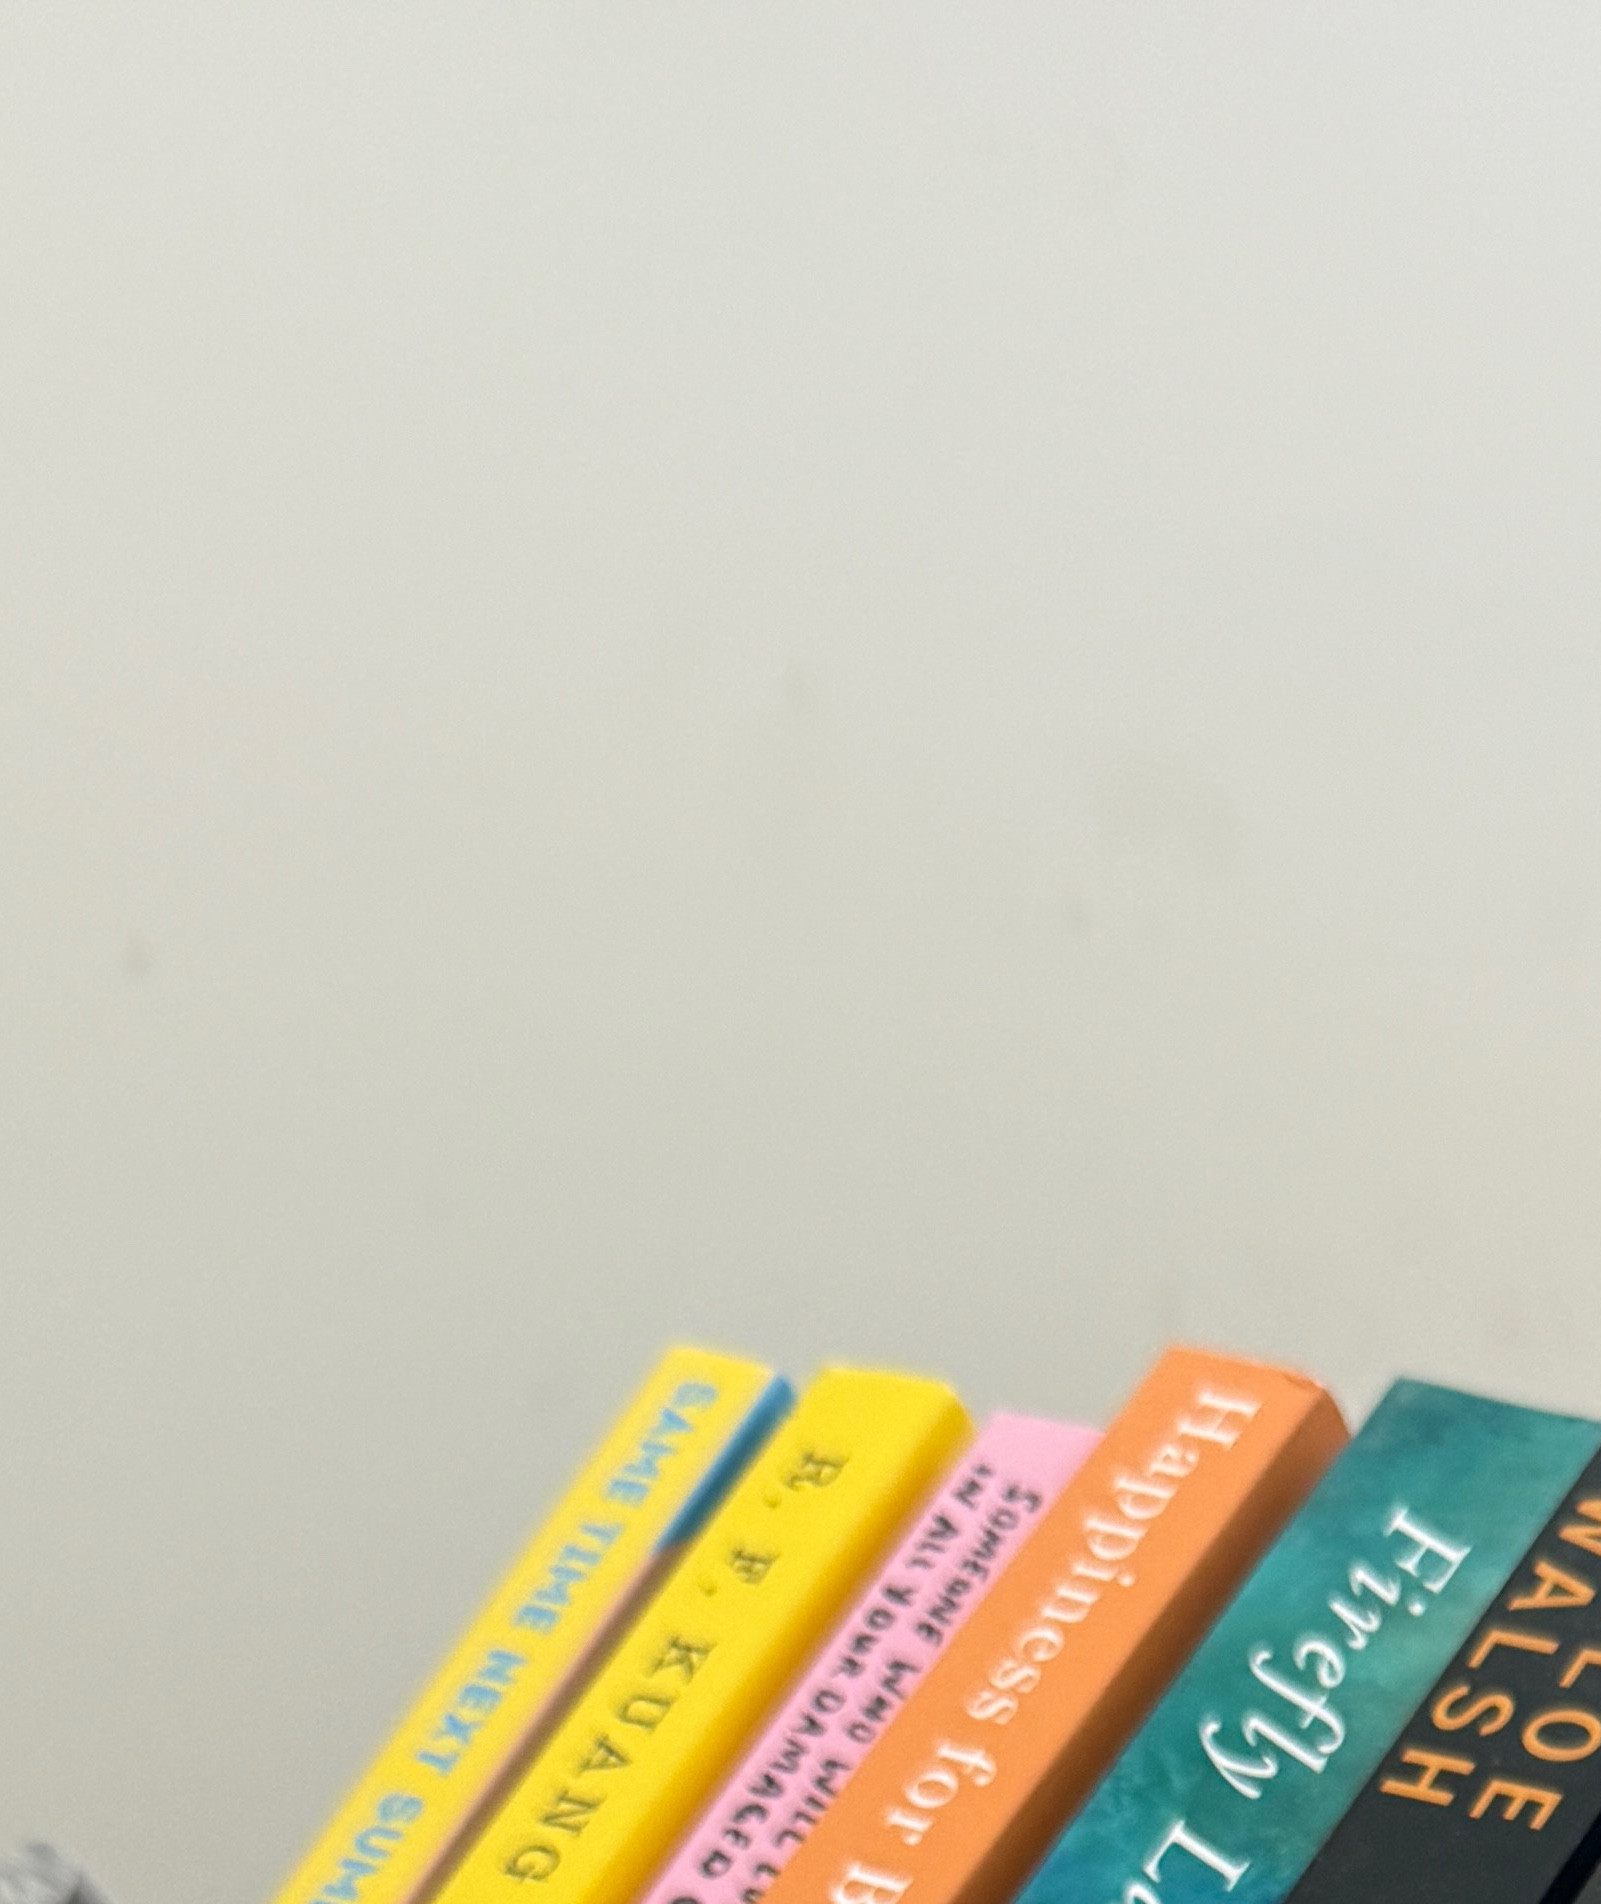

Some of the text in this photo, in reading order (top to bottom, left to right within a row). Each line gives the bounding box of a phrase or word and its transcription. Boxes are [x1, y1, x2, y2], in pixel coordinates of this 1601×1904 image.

[604, 1381, 719, 1506] SAME
[512, 1522, 622, 1637] TIME
[905, 1513, 959, 1571] ALL
[914, 1483, 1043, 1647] SOMEONE
[967, 1388, 1263, 1727] Happiness
[502, 1447, 849, 1886] R. F. KUANG
[829, 1581, 914, 1678] YOUR
[1200, 1504, 1472, 1801] Firefly
[418, 1649, 526, 1778] NEXT
[846, 1659, 921, 1744] WHO
[698, 1689, 847, 1880] DAMAGED
[886, 1740, 998, 1846] for
